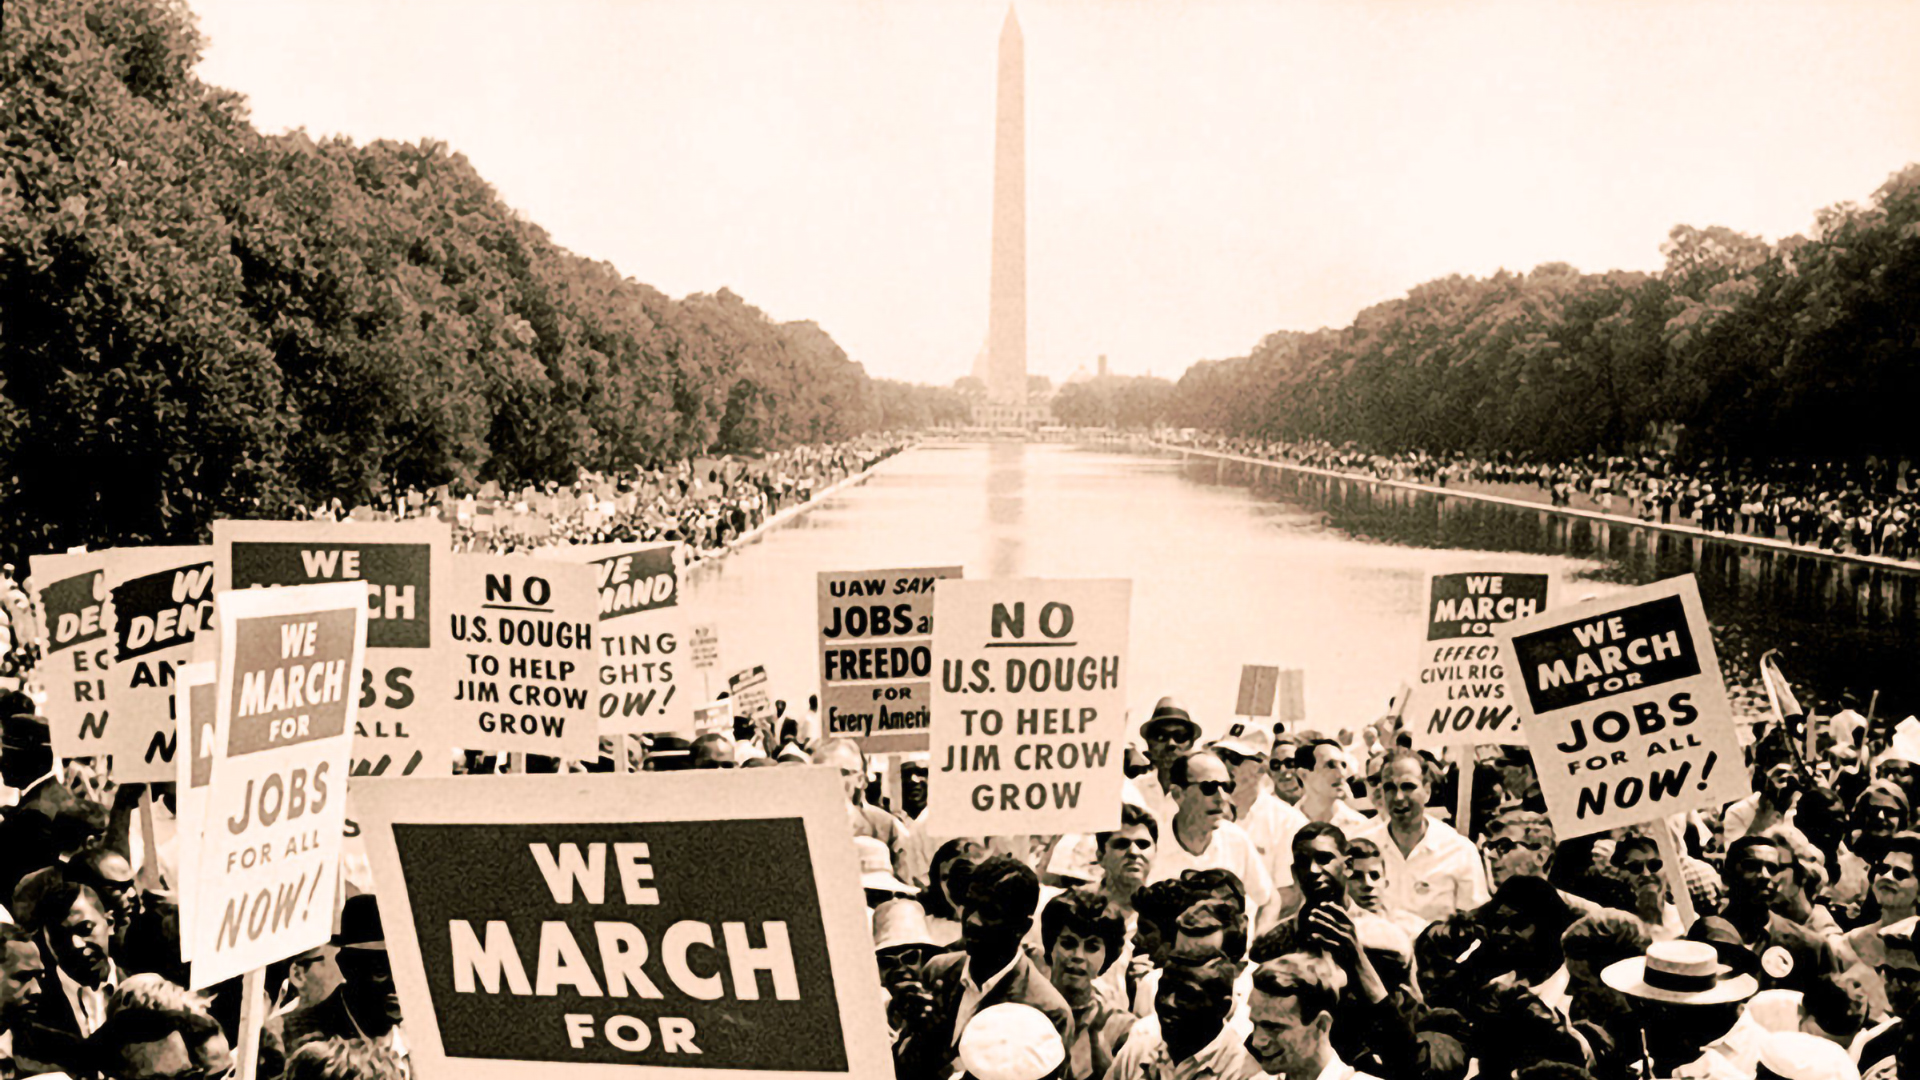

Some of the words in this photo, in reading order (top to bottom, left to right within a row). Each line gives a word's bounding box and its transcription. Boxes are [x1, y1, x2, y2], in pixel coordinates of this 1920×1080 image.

[301, 550, 360, 578] WE
[486, 574, 551, 605] NO
[830, 579, 886, 597] UAW
[893, 577, 935, 594] SAY
[1466, 575, 1503, 595] WE
[823, 604, 913, 638] JOBS
[991, 601, 1073, 639] NO
[1434, 597, 1537, 623] MARCH
[281, 621, 317, 659] WE
[451, 614, 492, 642] U.S.
[500, 618, 591, 650] DOUGH
[1461, 622, 1497, 635] FO
[1572, 616, 1626, 648] WE
[601, 633, 677, 656] TING
[466, 653, 499, 675] TO
[510, 657, 575, 681] HELP
[825, 646, 932, 680] FREEDO
[942, 658, 995, 693] U.S.
[1006, 655, 1119, 693] DOUGH
[1421, 666, 1463, 684] CIVIL
[1468, 664, 1504, 680] RIG
[1537, 630, 1681, 691] MARCH
[238, 659, 345, 717] MARCH
[454, 680, 499, 703] JIM
[509, 684, 588, 710] CROW
[872, 687, 911, 701] FOR
[1448, 683, 1505, 700] LAWS
[1587, 672, 1643, 696] FOR
[269, 714, 310, 742] FOR
[479, 712, 565, 738] GROW
[829, 706, 873, 737] Every
[960, 709, 1003, 736] TO
[1016, 707, 1098, 735] HELP
[1557, 692, 1698, 753] JOBS
[940, 745, 1001, 772] JIM
[1014, 741, 1111, 770] CROW
[1567, 750, 1629, 775] FOR
[1647, 733, 1702, 757] ALL
[227, 761, 329, 835] JOBS
[971, 781, 1082, 812] GROW
[1576, 750, 1718, 819] NOW!
[226, 843, 272, 874] FOR
[284, 829, 320, 859] ALL
[529, 842, 660, 905] WE
[216, 862, 323, 952] NOW!
[448, 919, 801, 1000] MARCH
[564, 1013, 703, 1054] FOR
